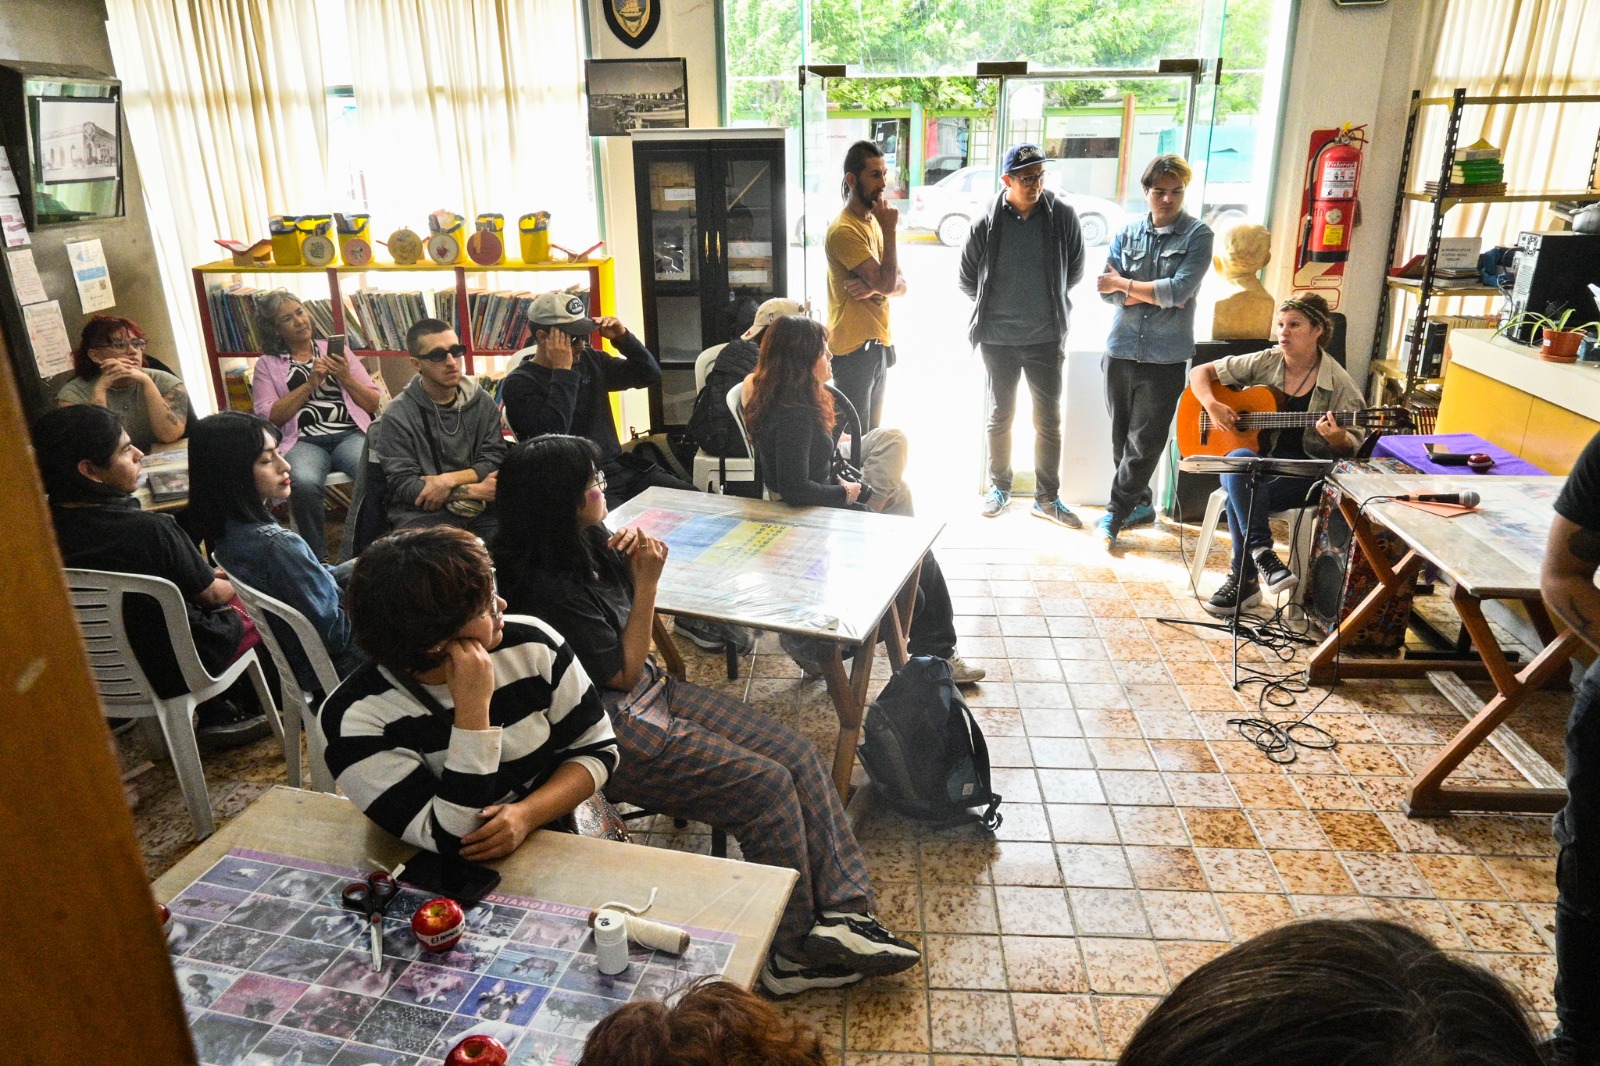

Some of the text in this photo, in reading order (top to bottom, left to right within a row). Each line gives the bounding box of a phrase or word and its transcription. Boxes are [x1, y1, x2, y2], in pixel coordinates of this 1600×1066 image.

[485, 894, 588, 917] DRÍAMOS VIVIR
[462, 935, 489, 943] ABAJO
